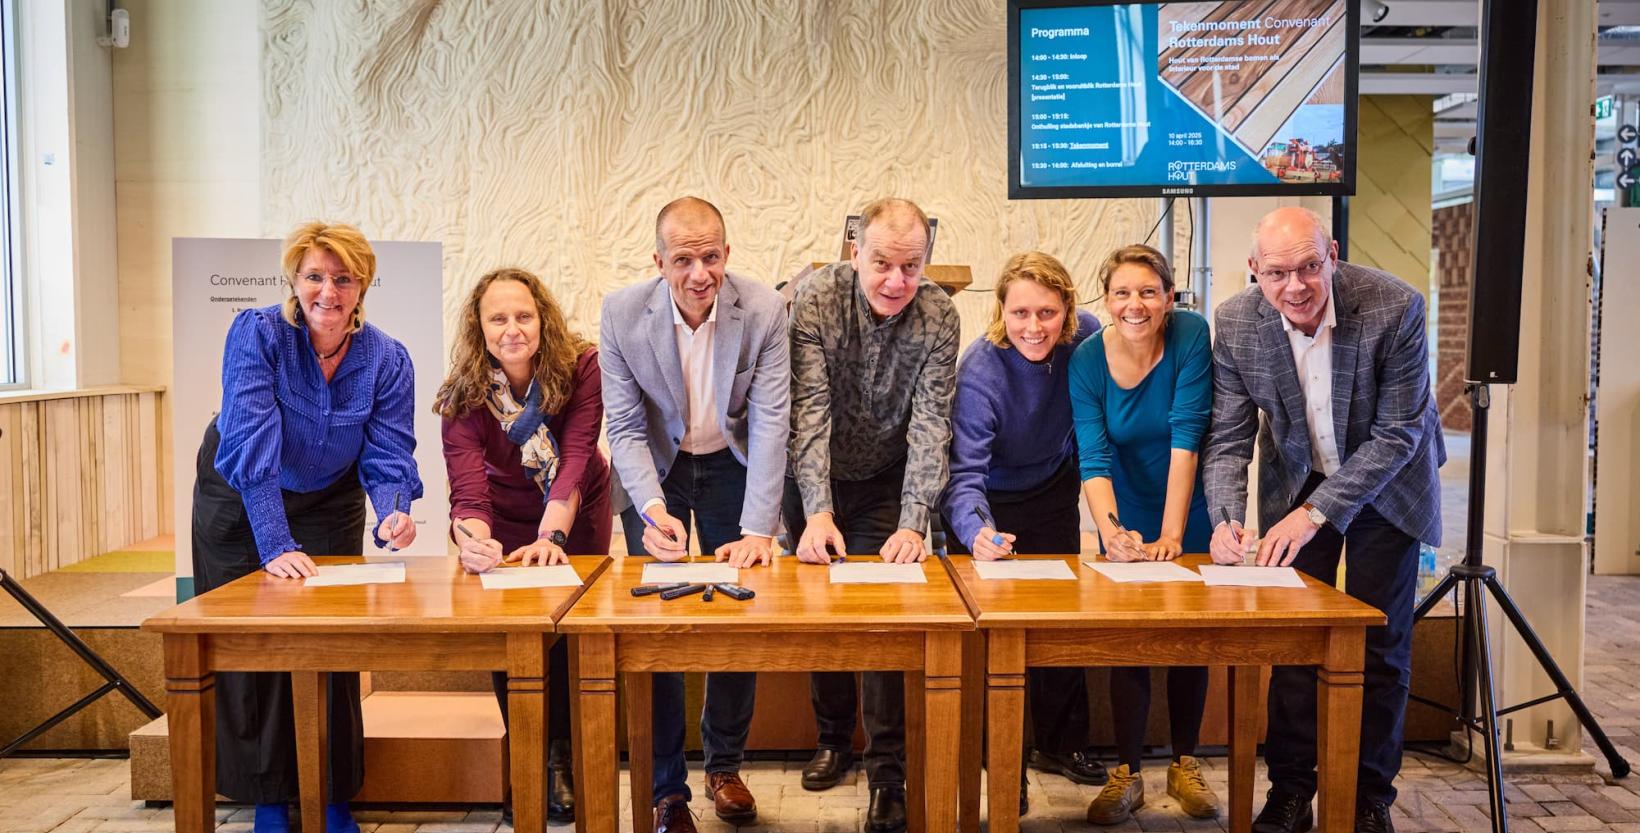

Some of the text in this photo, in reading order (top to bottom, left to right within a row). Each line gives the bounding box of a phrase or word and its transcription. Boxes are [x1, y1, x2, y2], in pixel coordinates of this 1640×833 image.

[1169, 16, 1330, 32] Tekenmoment Convenant
[1031, 28, 1089, 39] Programma
[1169, 34, 1280, 48] Rotterdams Hout
[1168, 161, 1236, 171] ROTTERDAMS
[1168, 171, 1195, 181] HOUT
[210, 274, 277, 286] Convenant
